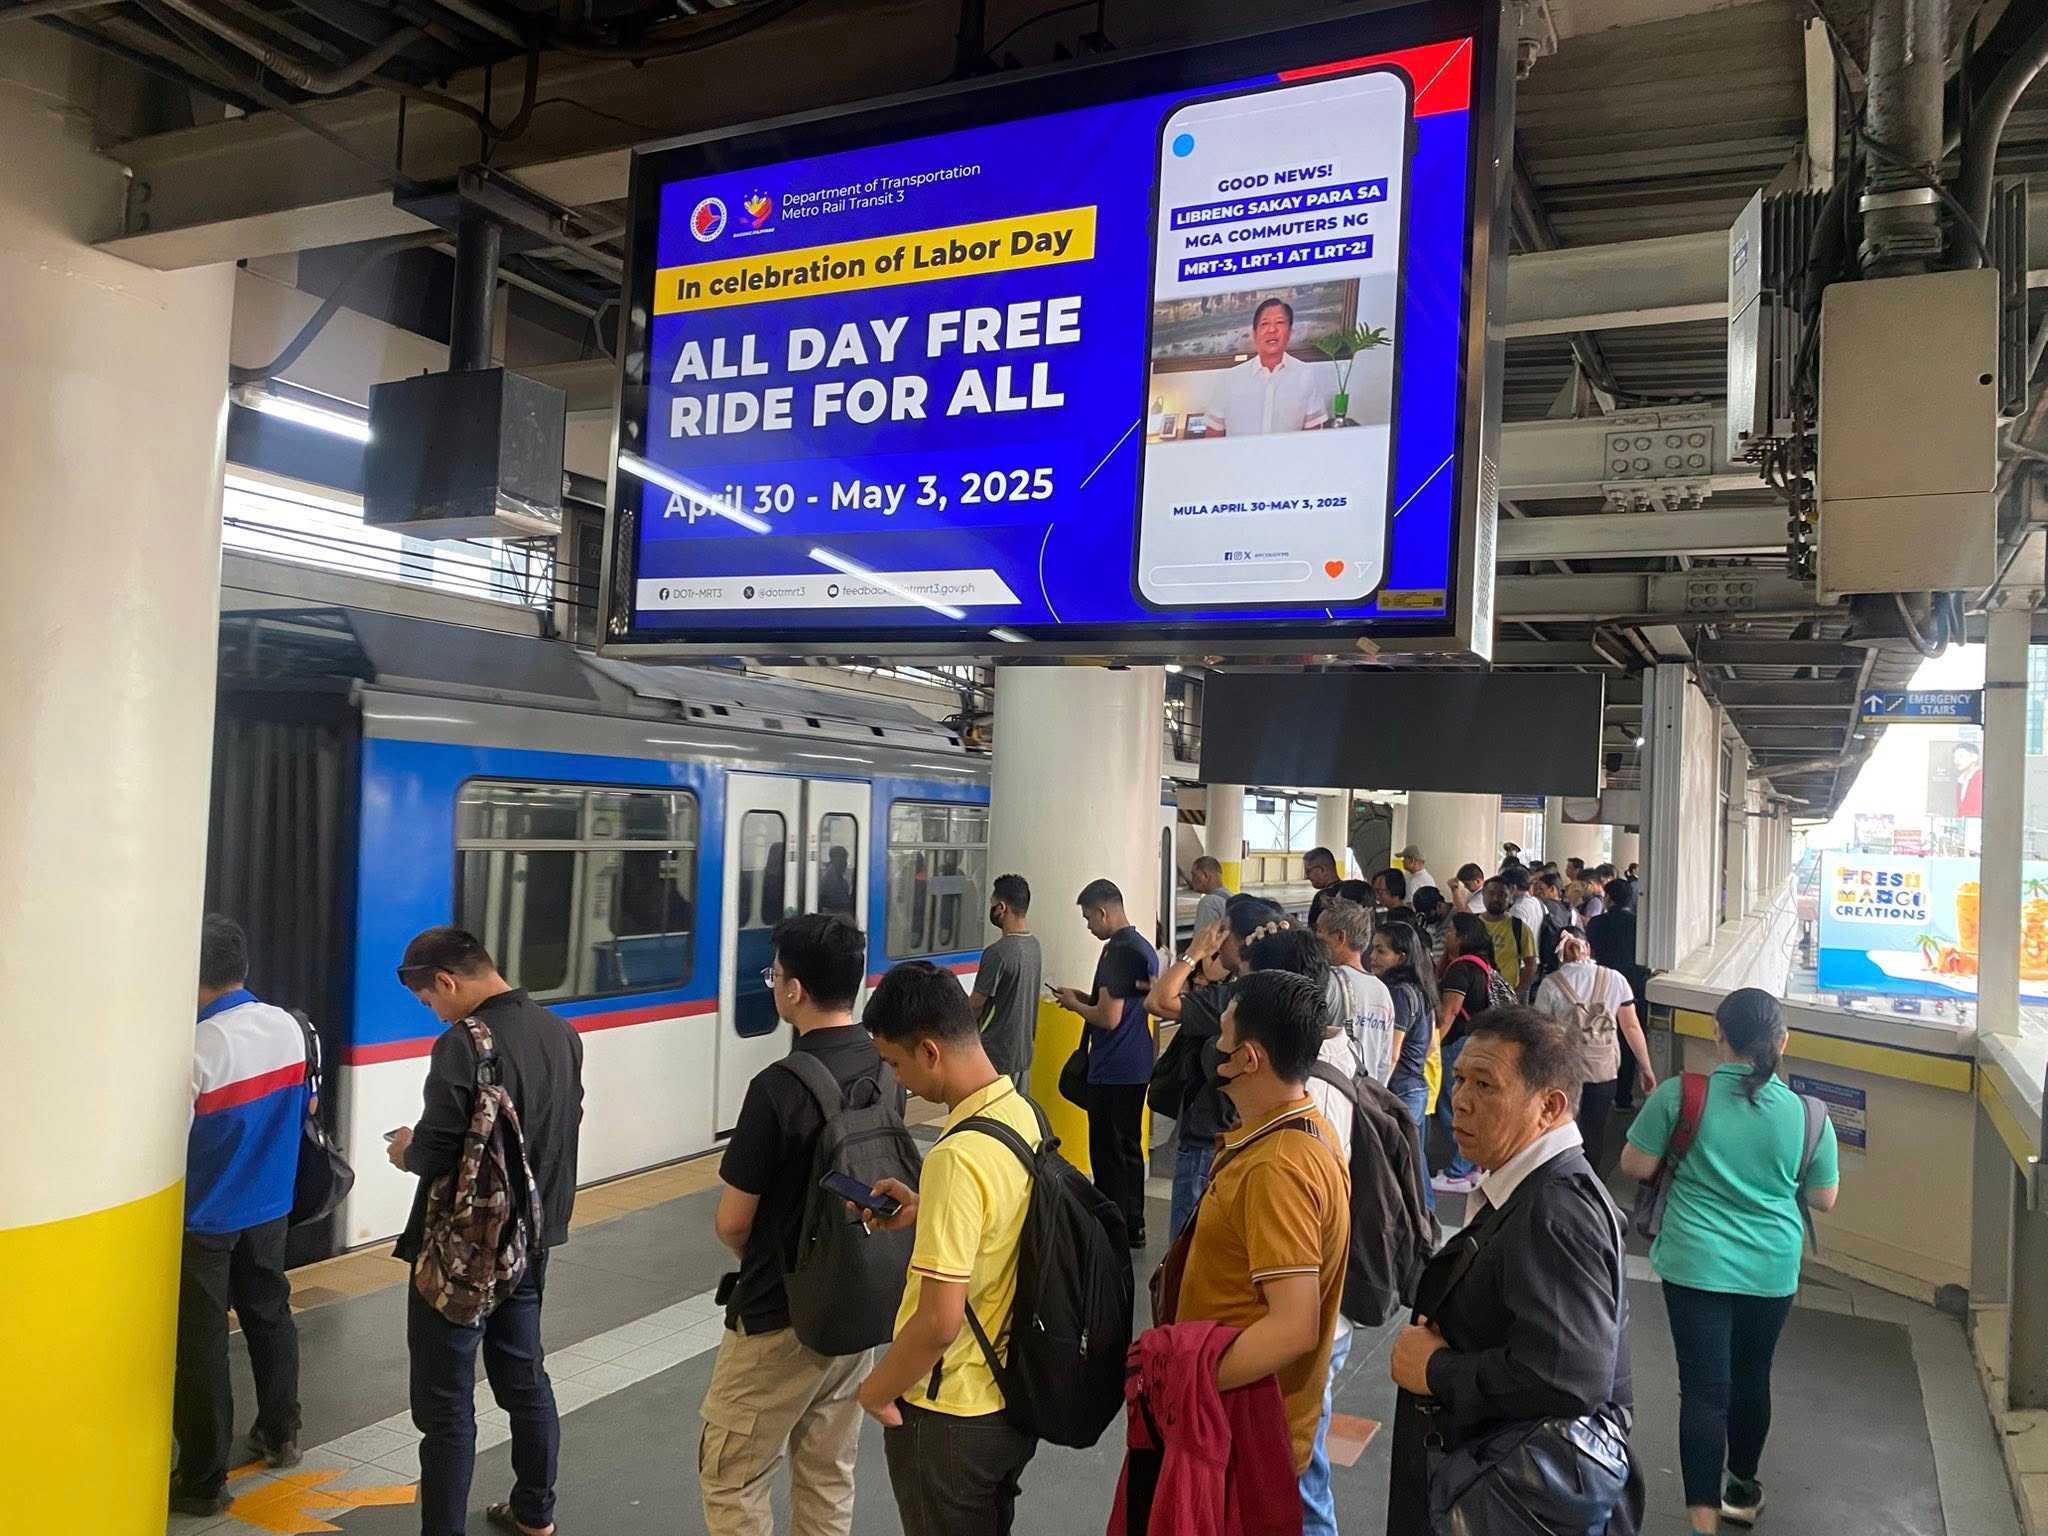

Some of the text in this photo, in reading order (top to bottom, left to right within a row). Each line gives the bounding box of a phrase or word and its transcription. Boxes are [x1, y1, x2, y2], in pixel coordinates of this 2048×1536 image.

[783, 163, 981, 208] Department of Transportation
[1217, 164, 1333, 193] GOOD NEWS!
[782, 190, 905, 221] Metro Rail Transit 3
[1176, 184, 1381, 226] LIBRENG SAKAY PARA SA
[1185, 211, 1369, 249] MGA COMMUTERS NG
[677, 227, 1074, 301] In celebration of Labor Day
[1184, 241, 1367, 277] MRT-3, LRT-1 AT LRT-2!
[670, 295, 1082, 383] ALL DAY FREE
[669, 361, 1065, 438] RIDE FOR ALL
[663, 484, 743, 524] April
[753, 483, 795, 514] 30
[831, 480, 906, 516] May
[916, 474, 948, 512] 3,
[960, 467, 1053, 504] 2025
[1173, 496, 1347, 516] MULA APRIL 30-MAY 3, 2025
[842, 582, 975, 598] feedbacotrmrt3.gov.ph
[1909, 693, 1971, 706] EMERGENCY
[1920, 704, 1956, 716] STAIRS
[1837, 867, 1921, 889] FRESH
[1836, 905, 1926, 920] CREATIONS
[1837, 887, 1927, 907] MANGO
